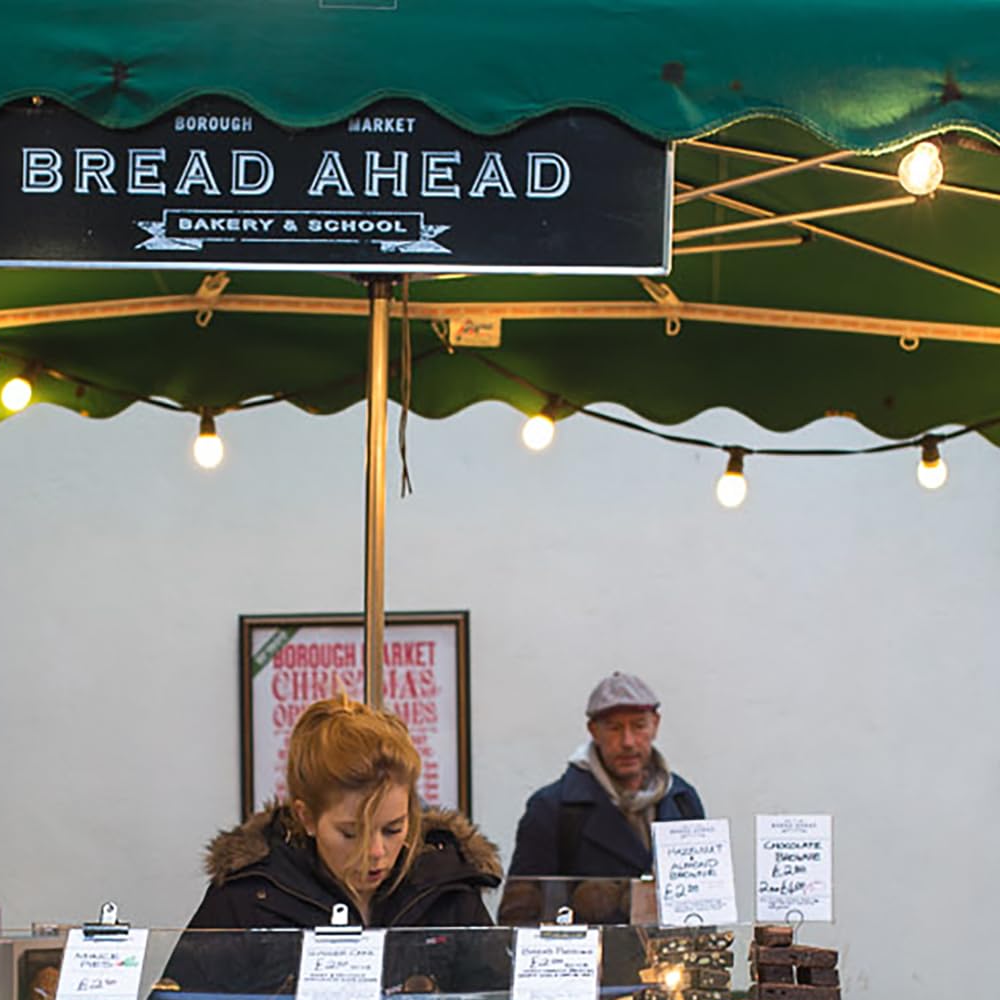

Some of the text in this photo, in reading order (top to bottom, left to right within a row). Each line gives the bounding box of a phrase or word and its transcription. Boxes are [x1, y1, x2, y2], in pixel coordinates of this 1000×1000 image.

[174, 115, 416, 133] BOROUGH MARKET
[21, 147, 571, 199] BREAD AHEAD
[178, 217, 408, 233] BAKERY & SCHOOL
